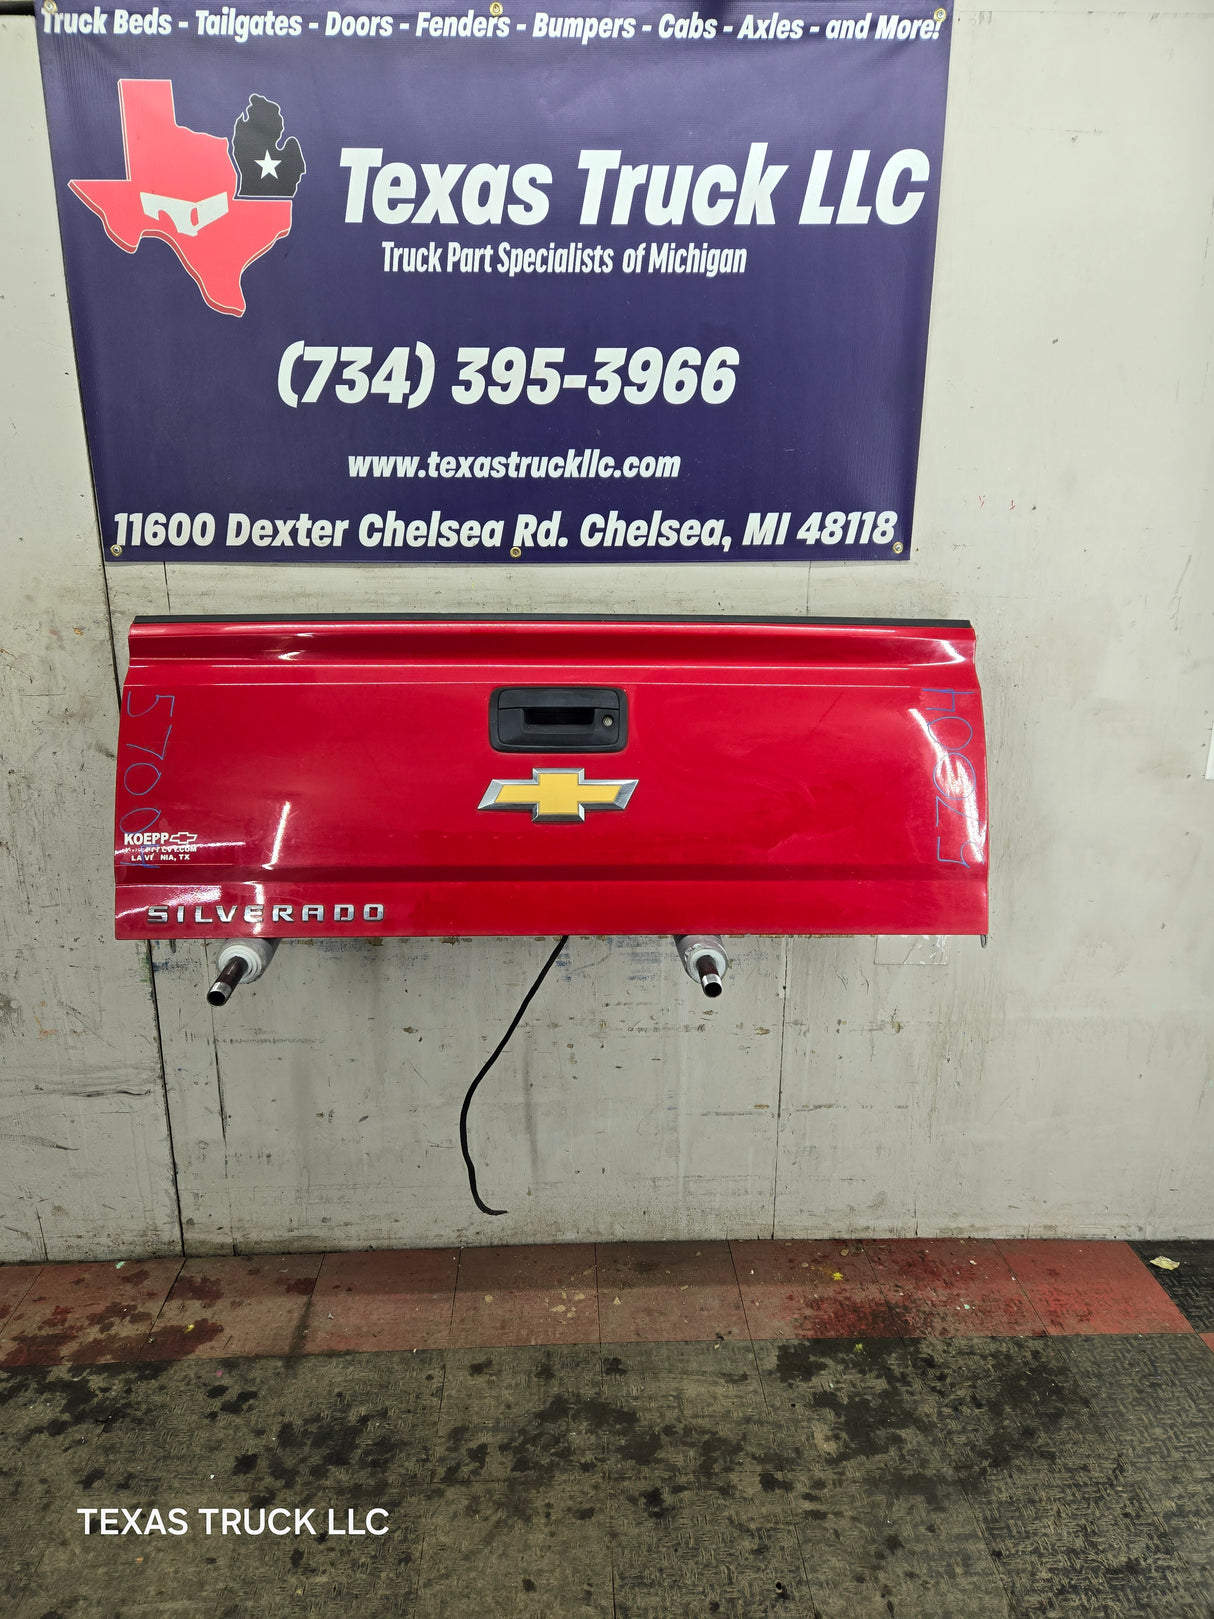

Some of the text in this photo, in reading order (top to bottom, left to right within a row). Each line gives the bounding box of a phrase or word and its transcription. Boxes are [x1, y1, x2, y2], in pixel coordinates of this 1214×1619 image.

[41, 6, 107, 34] Truck
[113, 9, 172, 35] Beds
[196, 10, 302, 42] Tailgates
[325, 11, 393, 37] Doors
[416, 9, 511, 38] Fenders
[532, 13, 636, 44] Bumpers
[658, 12, 717, 39] Cabs
[737, 12, 804, 39] Axles
[825, 12, 873, 39] and
[874, 15, 942, 40] More!
[339, 142, 930, 226] Texas Truck LLC
[382, 241, 748, 277] Truck Part Specialists of Michigan
[277, 340, 740, 409] (734) 395-3966
[348, 448, 681, 478] www.texastruckllc.com
[113, 510, 899, 552] 11600 Dexter Chelsea Rd. Chelsea, MI 48118
[123, 832, 169, 846] KOEPP
[147, 903, 385, 923] SILVERADO
